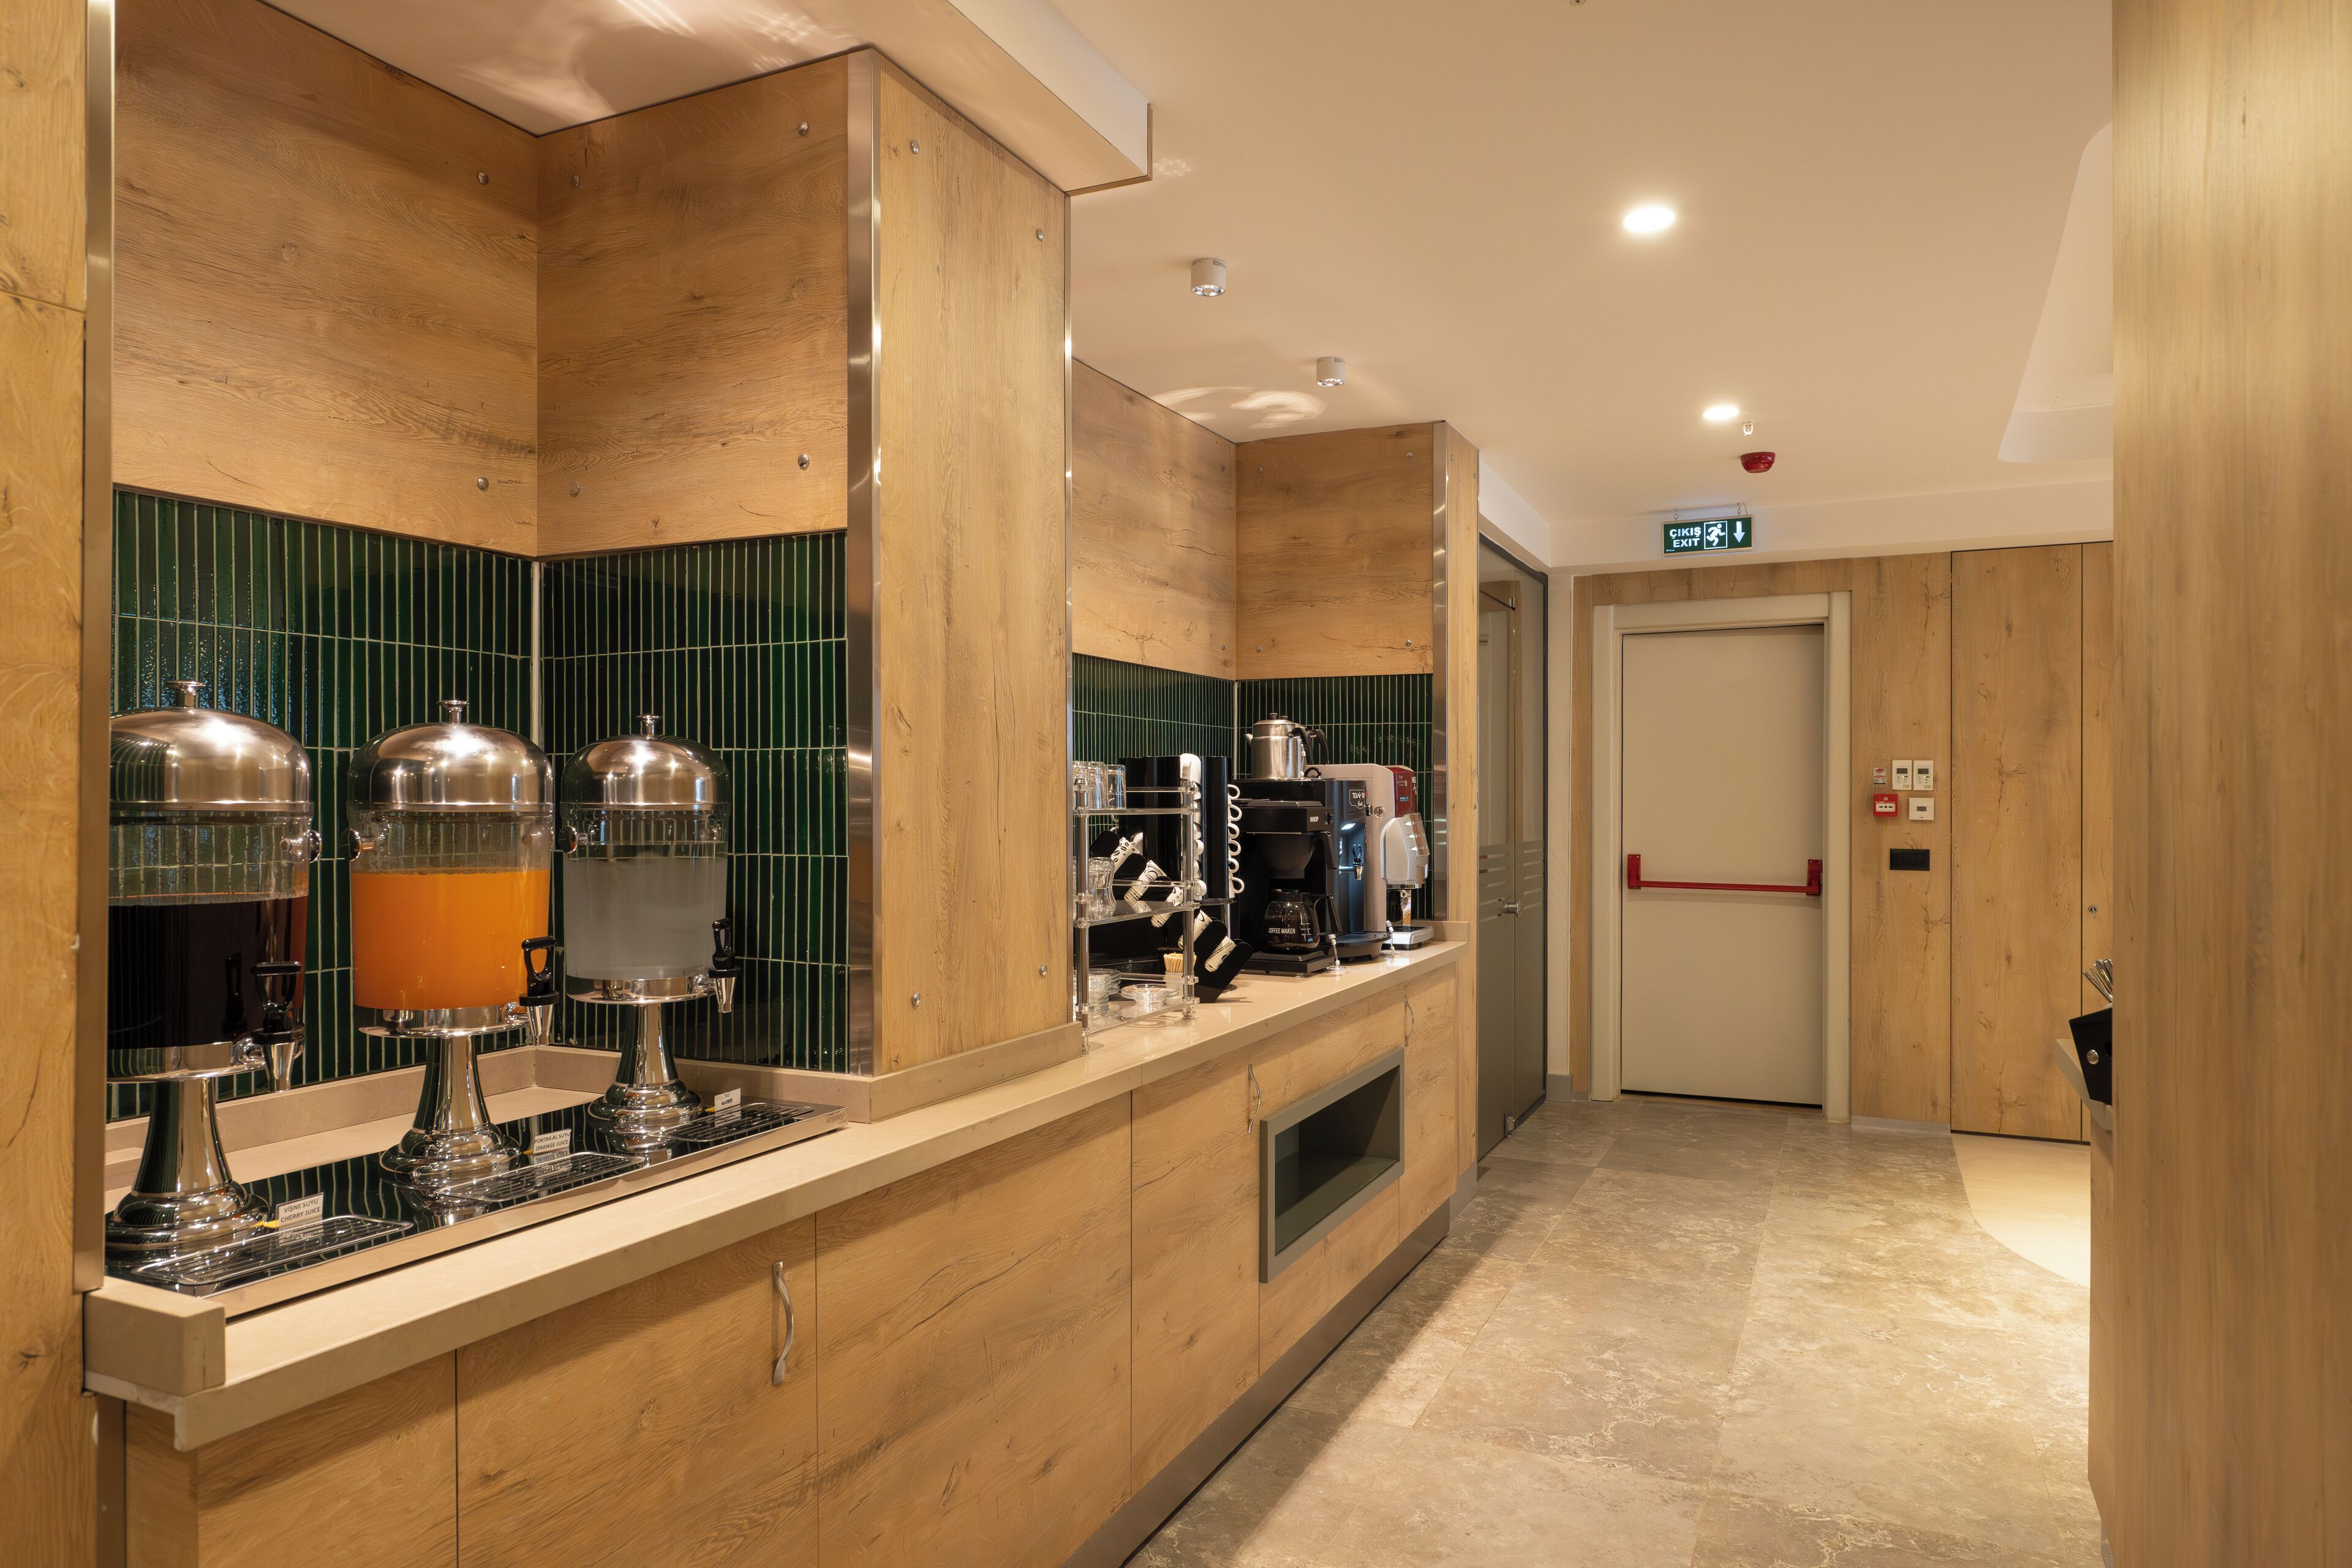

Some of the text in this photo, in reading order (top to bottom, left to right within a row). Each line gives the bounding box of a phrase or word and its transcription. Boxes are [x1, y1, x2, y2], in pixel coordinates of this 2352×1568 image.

[1670, 527, 1702, 539] ÇIKIŞ
[1673, 538, 1700, 548] EXIT
[534, 1135, 557, 1144] PORTAKAL
[284, 1199, 318, 1213] VİŞNE SUYU
[281, 1207, 321, 1223] CHERRY JUICE
